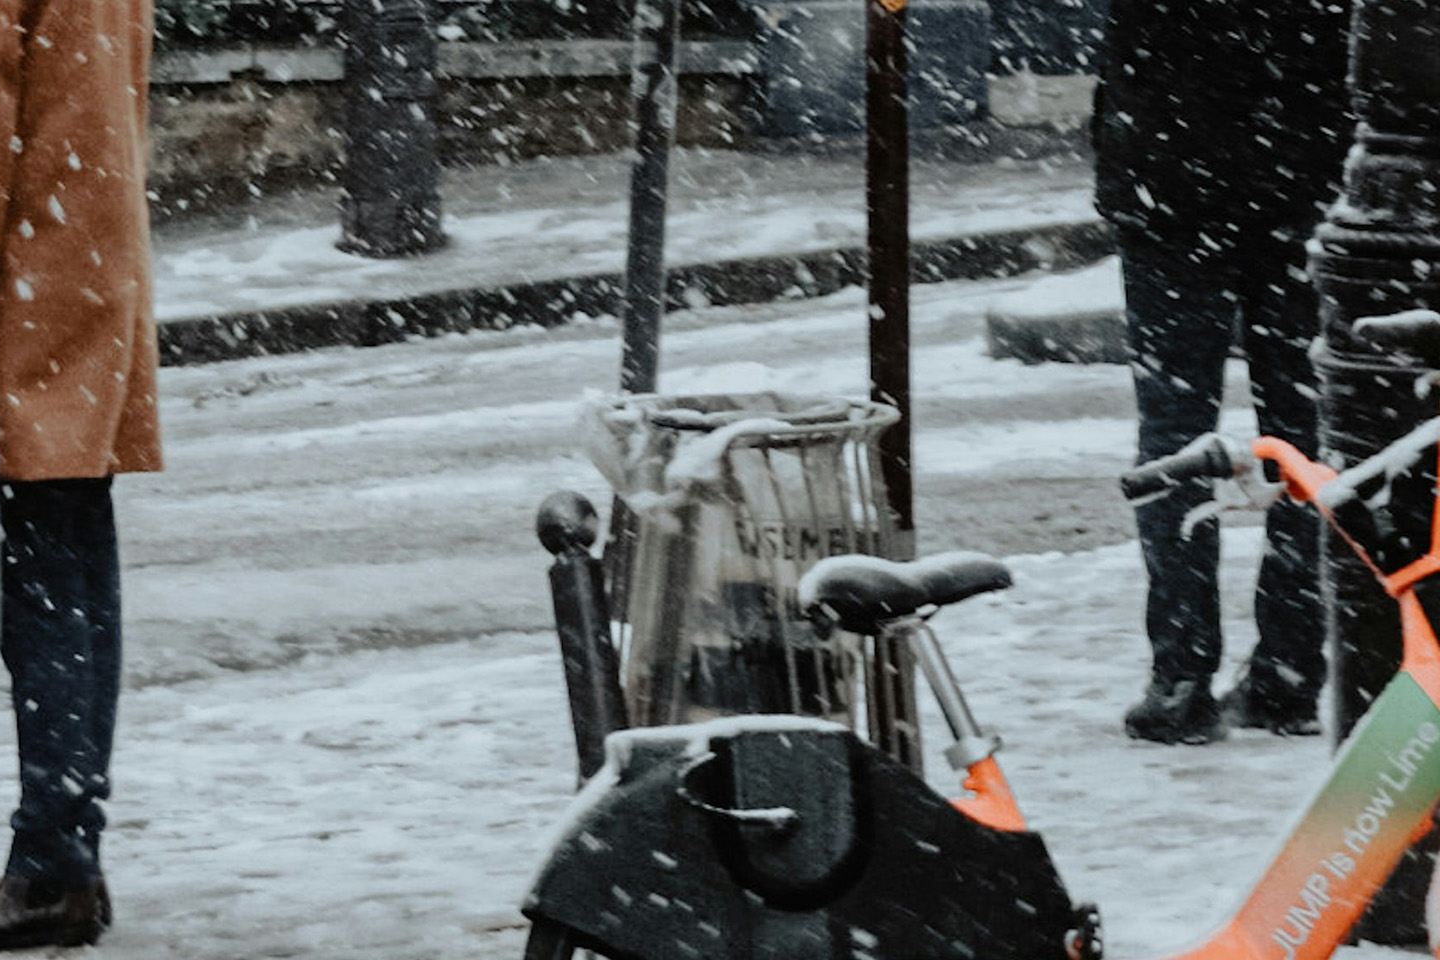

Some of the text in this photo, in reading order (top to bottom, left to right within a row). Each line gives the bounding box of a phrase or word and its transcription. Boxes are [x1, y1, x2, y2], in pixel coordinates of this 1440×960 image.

[1271, 720, 1440, 960] JUMP is now Lime
